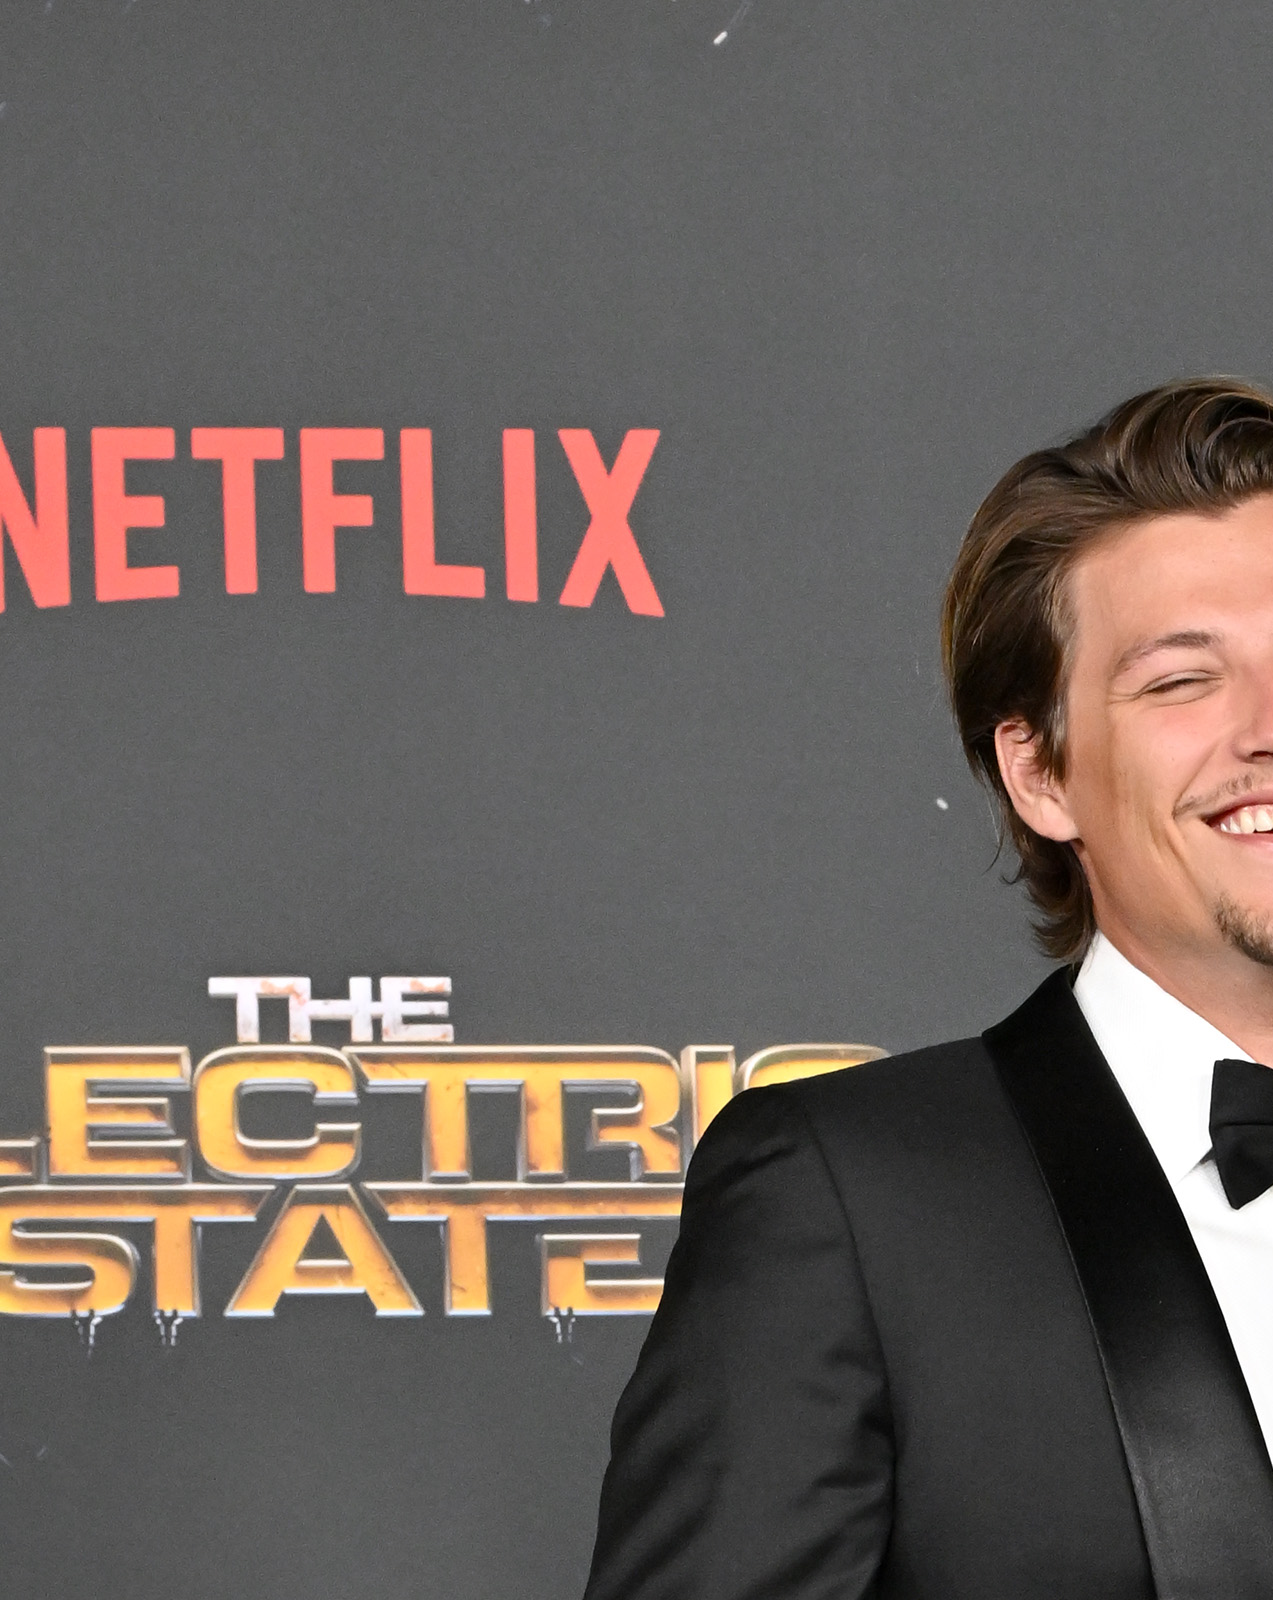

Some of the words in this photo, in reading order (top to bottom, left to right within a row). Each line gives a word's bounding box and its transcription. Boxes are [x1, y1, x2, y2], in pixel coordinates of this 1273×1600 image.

[0, 427, 664, 617] NETFLIX
[208, 976, 453, 1043] THE
[0, 1183, 685, 1318] STATE
